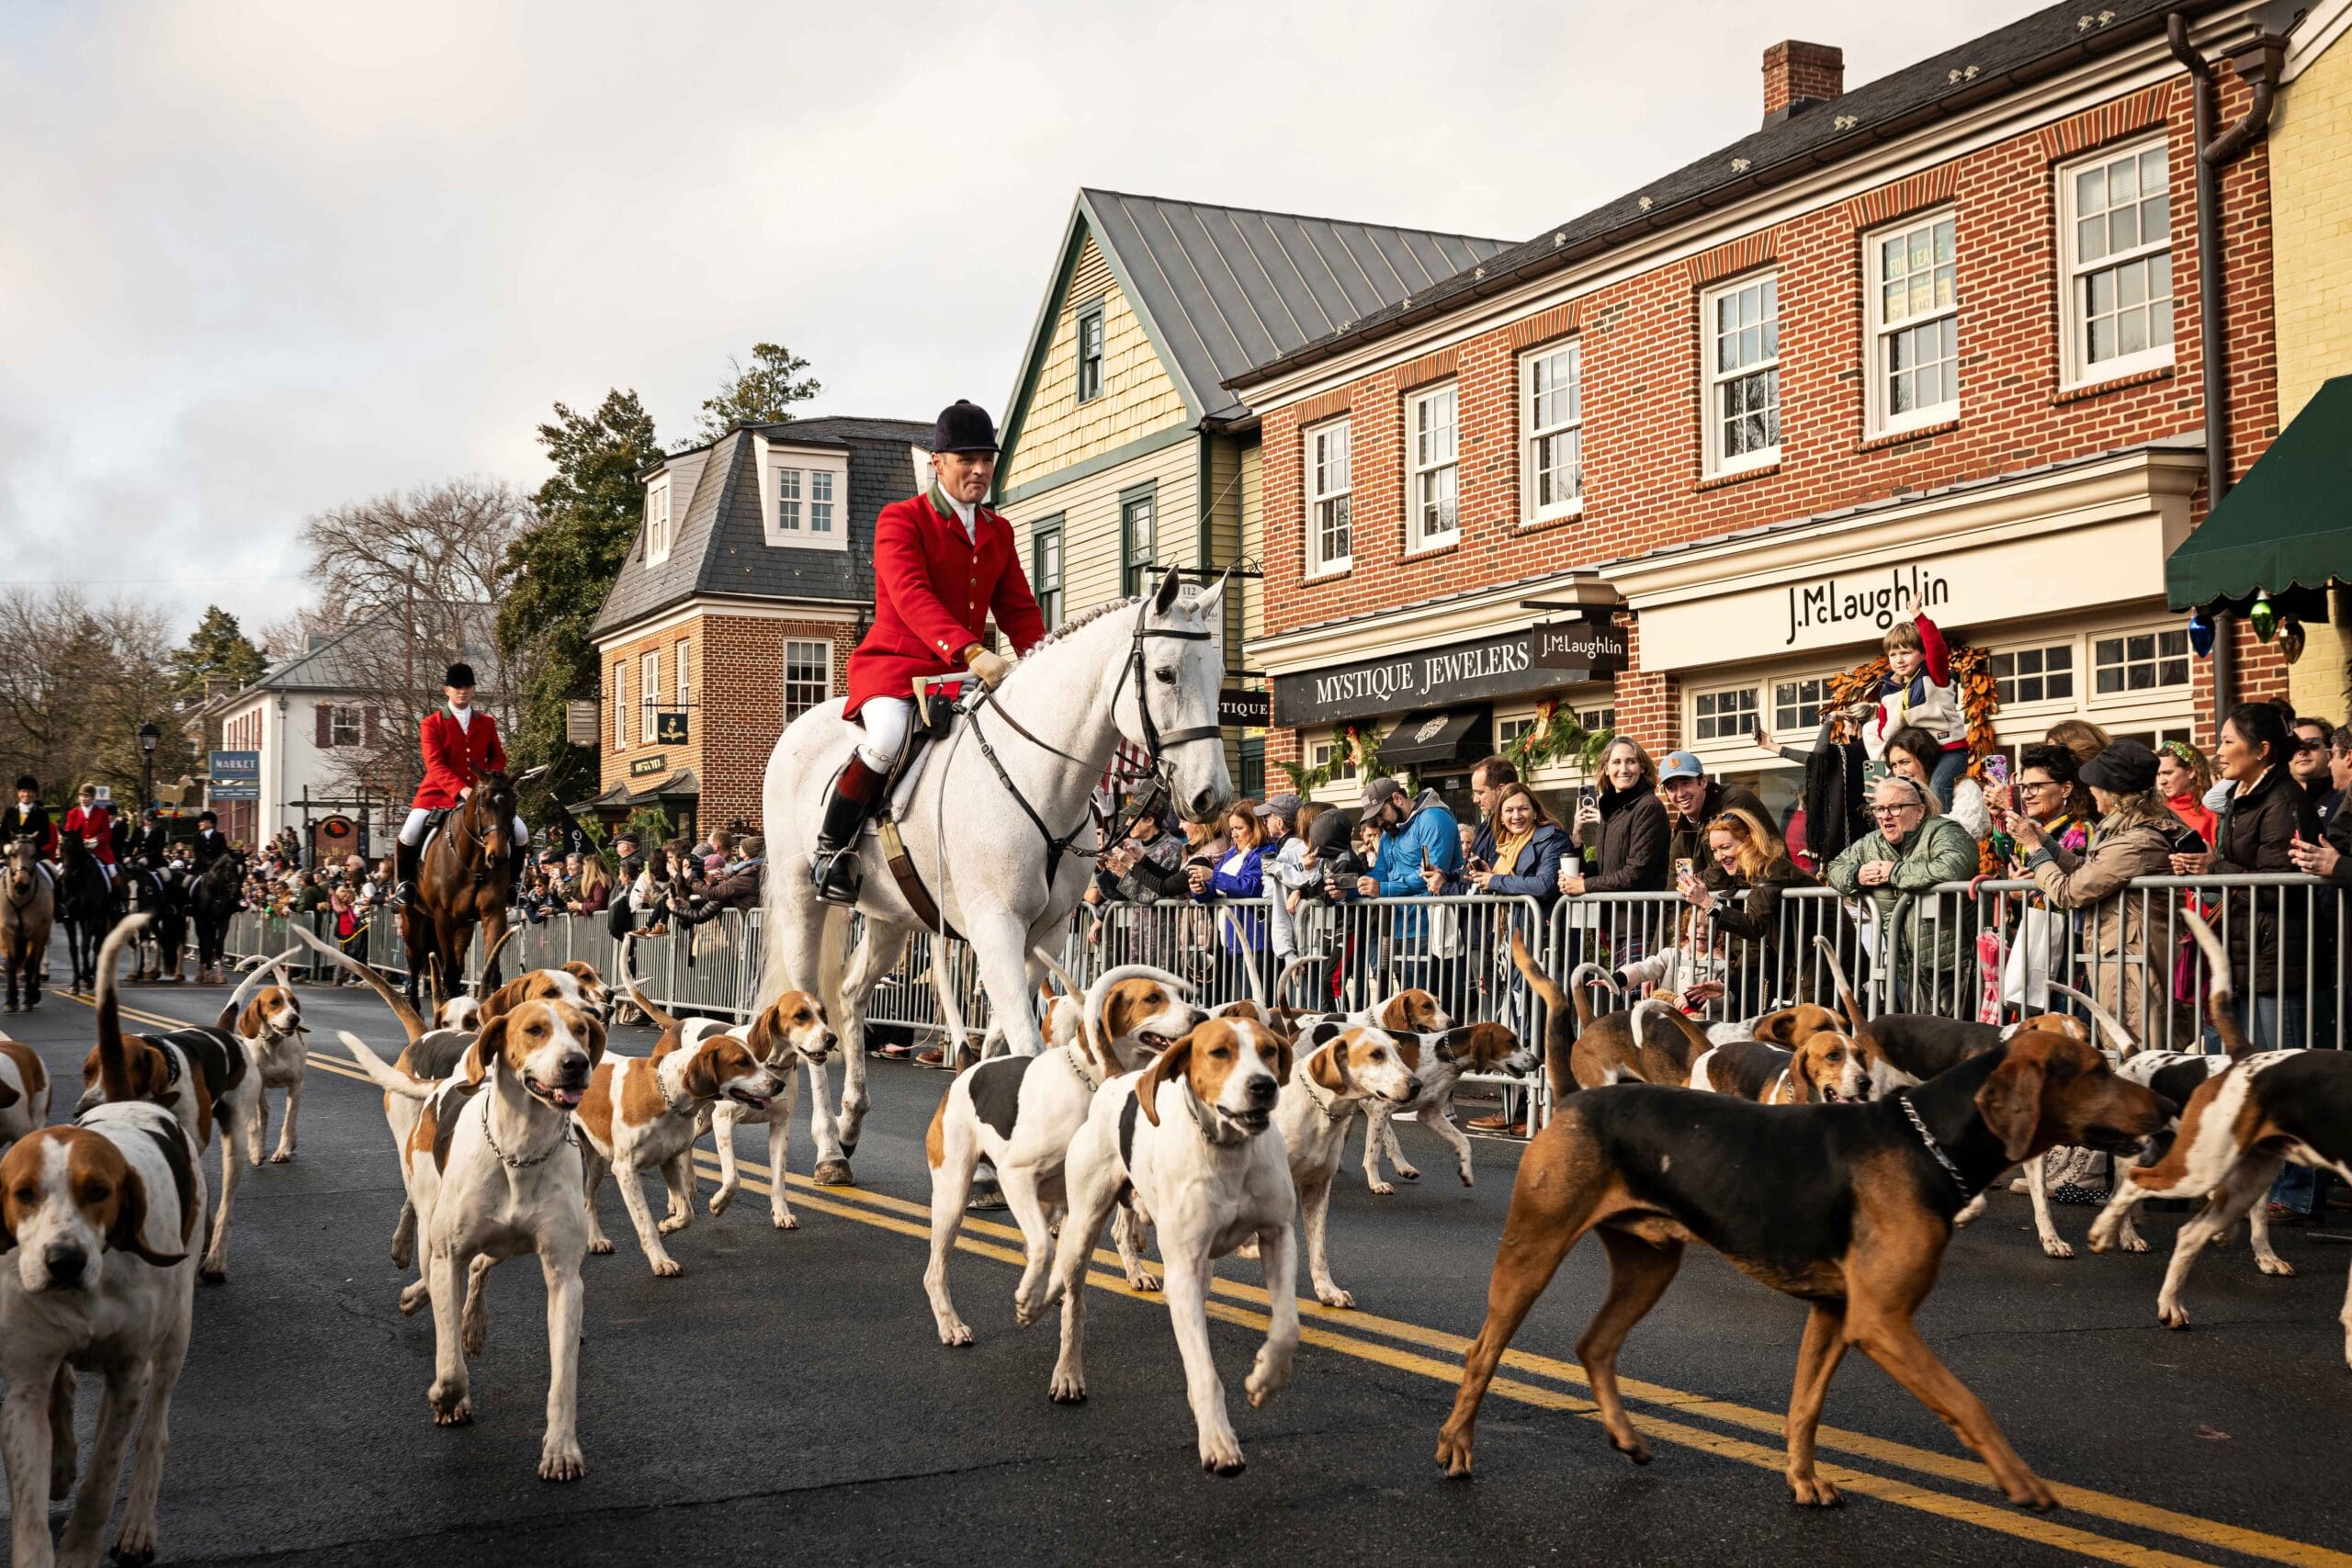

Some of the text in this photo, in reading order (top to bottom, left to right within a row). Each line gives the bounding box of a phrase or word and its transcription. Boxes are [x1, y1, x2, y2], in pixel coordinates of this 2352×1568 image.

[1182, 586, 1196, 596] 112
[1786, 565, 1949, 645] J.McLaughlin
[1541, 633, 1622, 660] J.McLaughlin
[1316, 641, 1530, 705] MYSTIQUE JEWELERS
[1217, 702, 1268, 717] TIQUE
[215, 759, 255, 769] MARKET
[571, 829, 582, 852] OP
